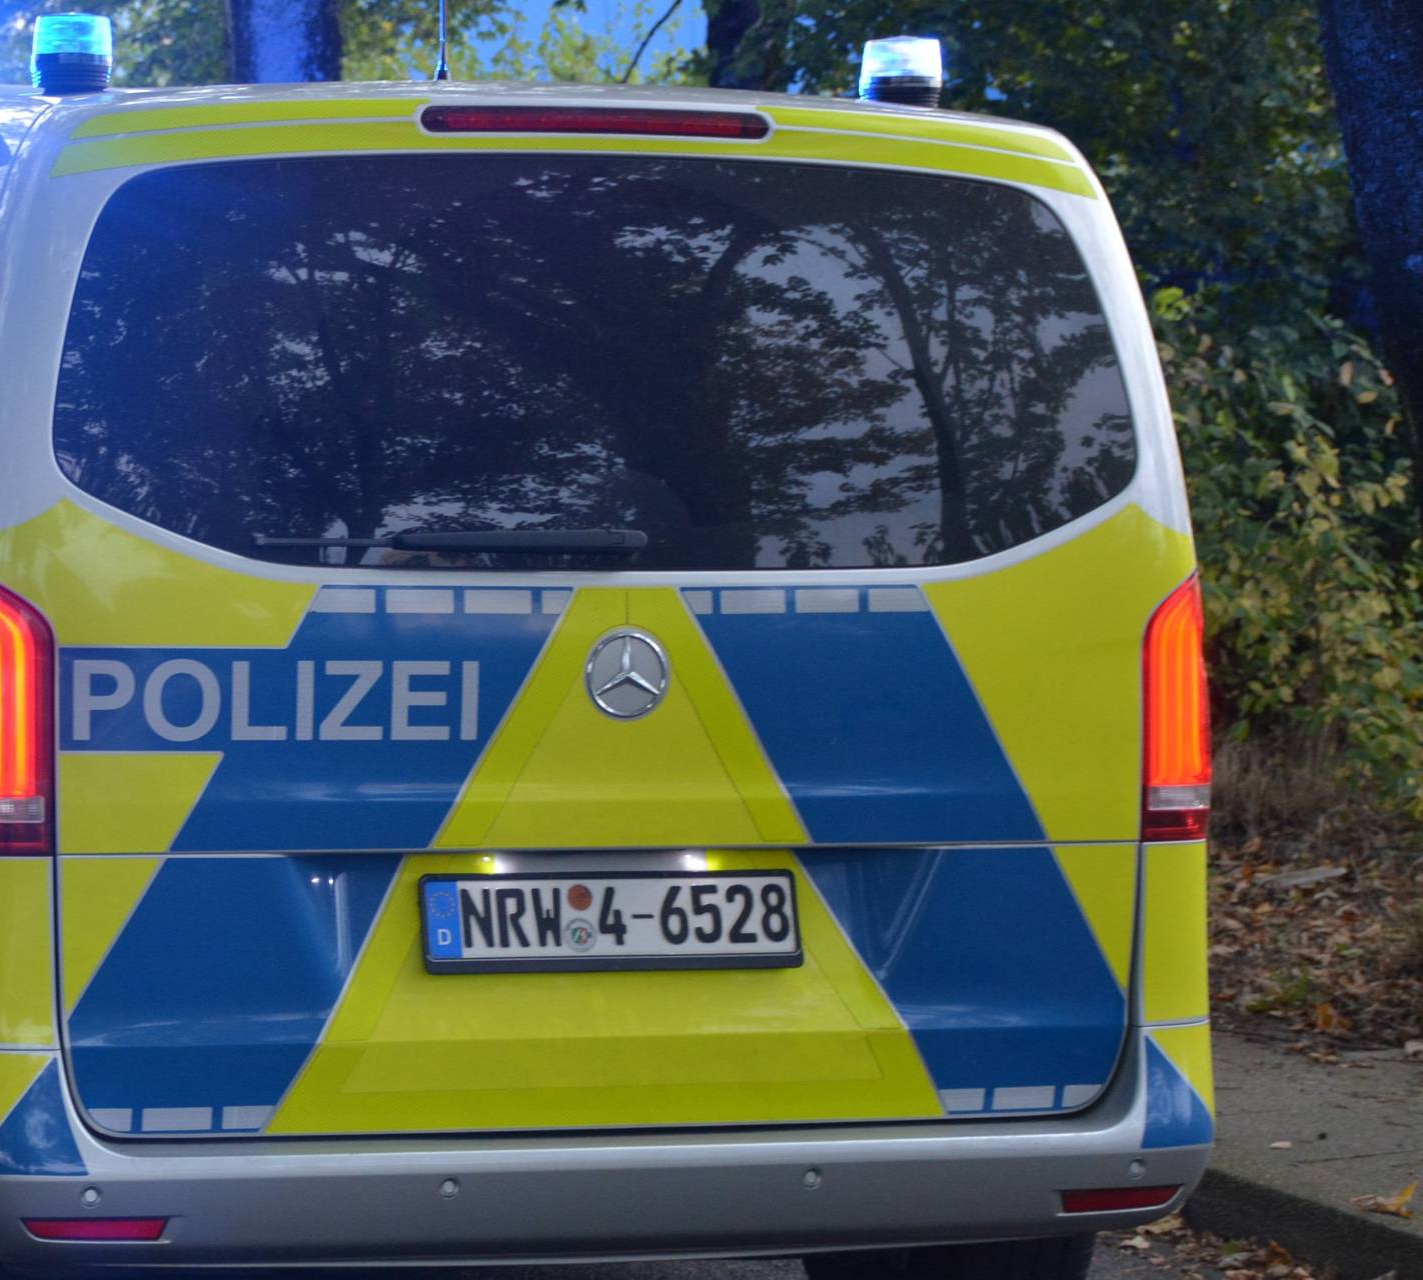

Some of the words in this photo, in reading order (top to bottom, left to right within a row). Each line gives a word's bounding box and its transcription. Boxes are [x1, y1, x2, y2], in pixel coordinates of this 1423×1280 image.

[72, 658, 480, 742] POLIZEI
[437, 928, 452, 945] D
[460, 887, 562, 948] NRW
[598, 884, 790, 946] 4-6528
